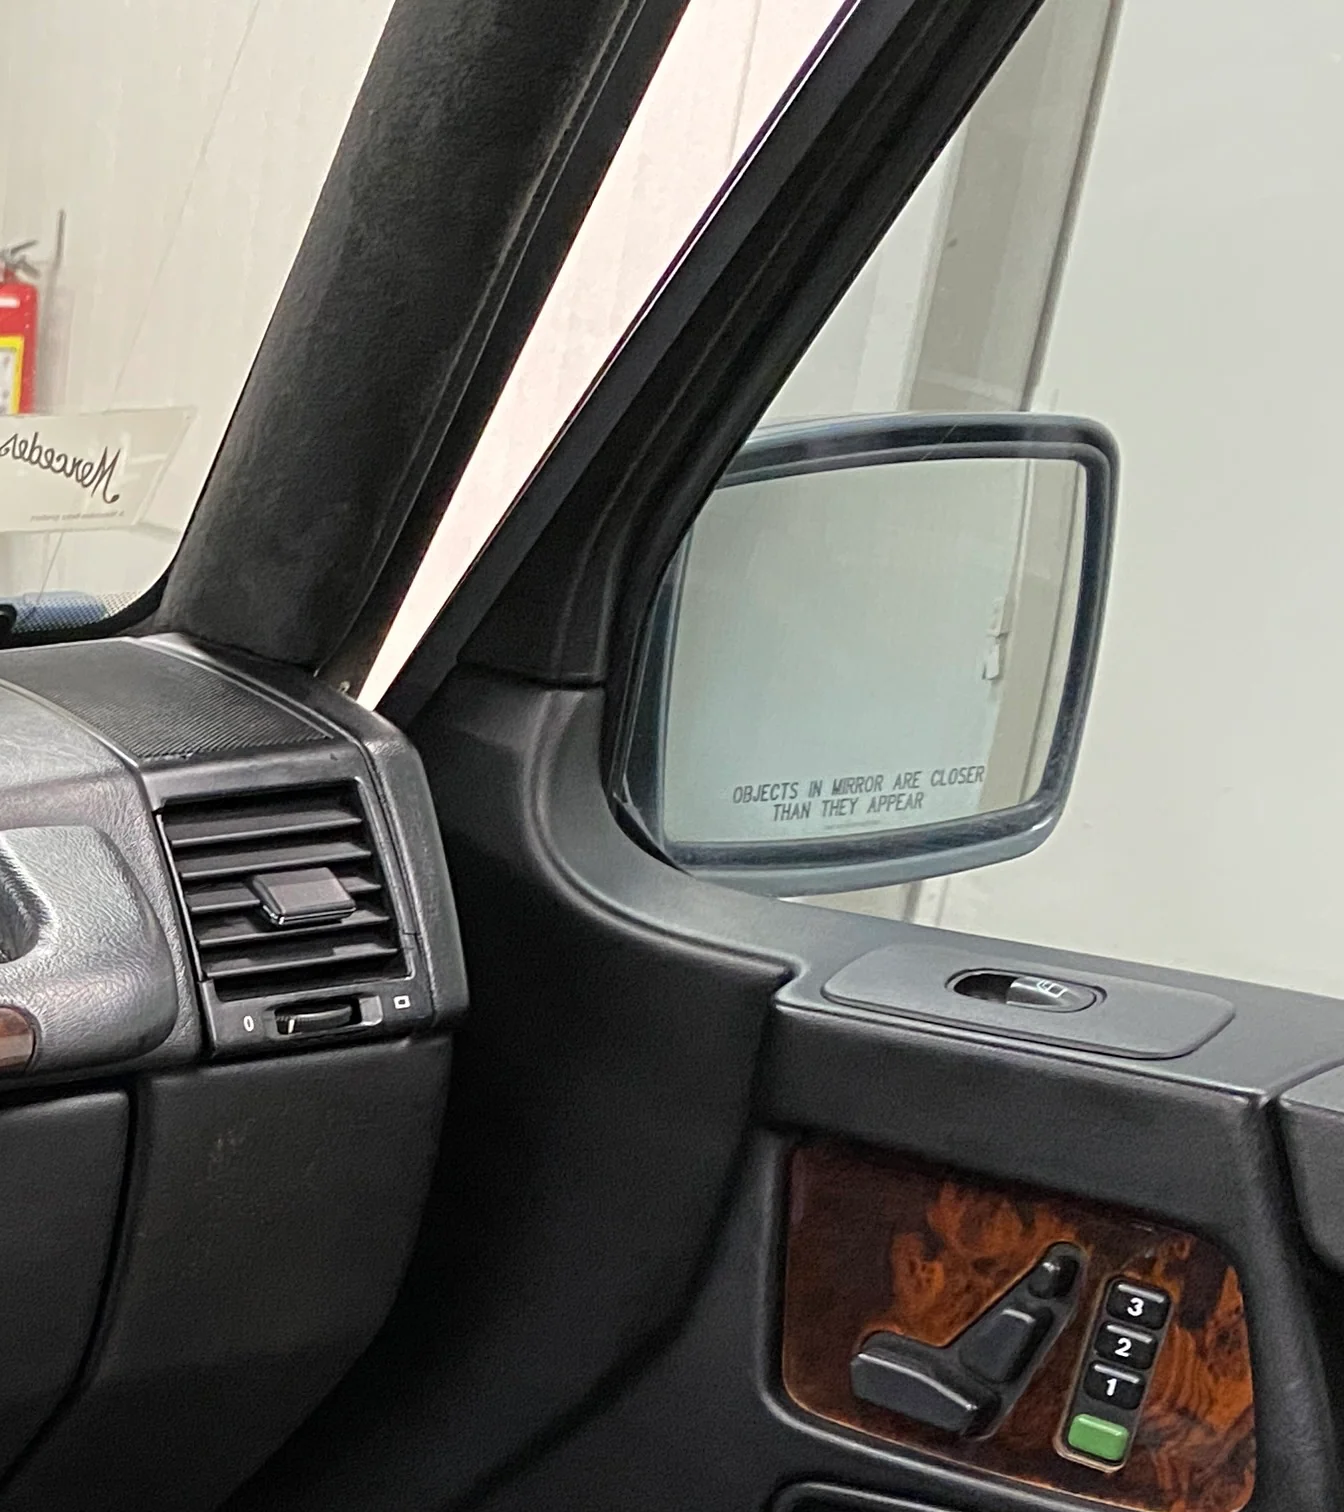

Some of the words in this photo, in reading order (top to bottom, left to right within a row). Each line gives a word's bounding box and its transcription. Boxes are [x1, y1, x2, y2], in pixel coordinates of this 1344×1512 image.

[732, 782, 799, 804] OBJECTS
[808, 780, 823, 797] IN
[831, 775, 884, 796] MIRROR
[893, 771, 922, 791] ARE
[931, 765, 985, 787] CLOSER
[773, 801, 810, 821] THAN
[822, 797, 859, 817] THEY
[867, 792, 924, 813] APPEAR
[1127, 1297, 1144, 1317] 3
[1114, 1337, 1132, 1357] 2
[1106, 1378, 1118, 1396] 1
